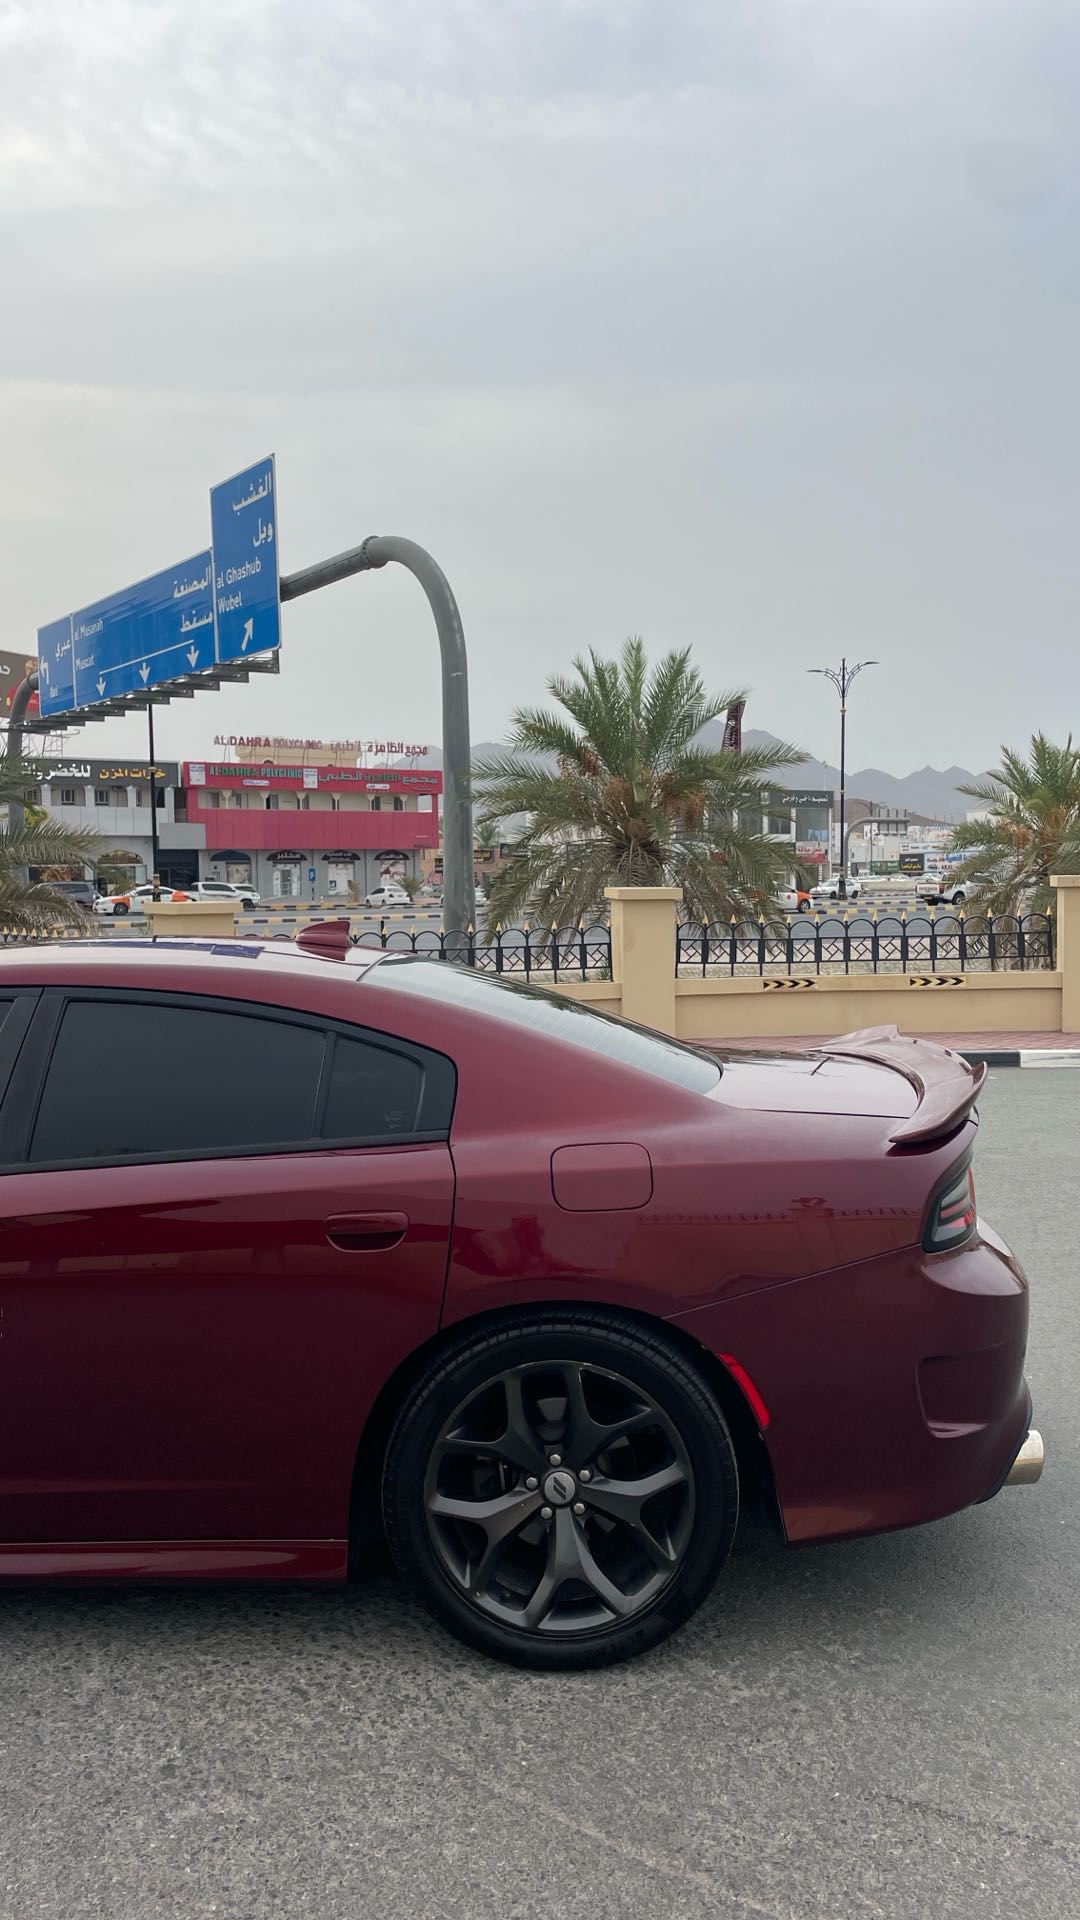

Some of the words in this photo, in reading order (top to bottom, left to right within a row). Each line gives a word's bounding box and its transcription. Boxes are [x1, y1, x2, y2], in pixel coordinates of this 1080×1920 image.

[232, 473, 272, 516] الغشب
[252, 517, 273, 547] وبل
[173, 564, 212, 599] المصنعة
[216, 571, 225, 589] al
[226, 556, 262, 585] Ghashub
[217, 590, 243, 614] Wubel
[180, 610, 213, 633] مسقط
[55, 639, 72, 662] عبري
[75, 653, 95, 673] Muscat
[404, 744, 428, 757] مجمع
[129, 766, 166, 781] خرات
